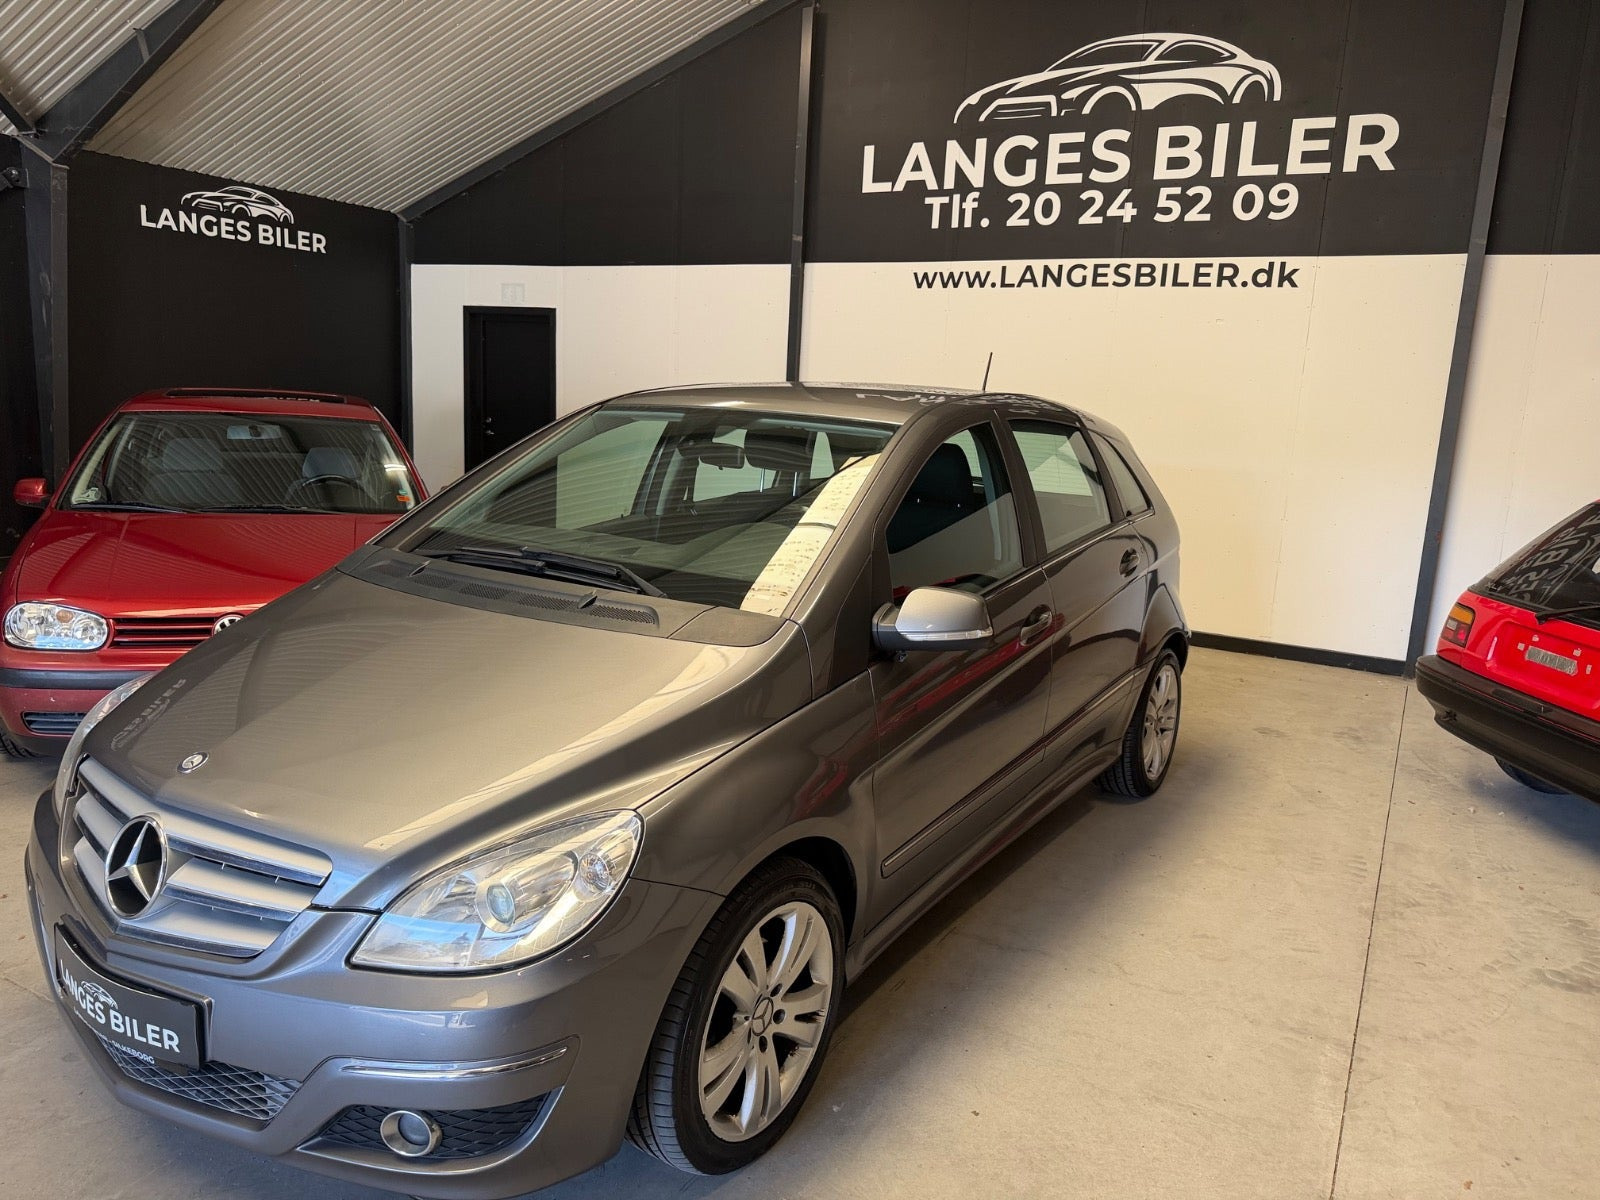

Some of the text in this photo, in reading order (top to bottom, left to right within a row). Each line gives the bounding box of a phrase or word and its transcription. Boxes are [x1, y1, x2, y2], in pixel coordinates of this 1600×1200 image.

[861, 113, 1400, 194] LANGES BILER
[140, 204, 327, 254] LANGES BILER
[924, 182, 1299, 230] Tlf. 20 24 52 09
[913, 261, 1300, 290] www.LANGESBILER.dk
[60, 958, 106, 1025] LANGES
[109, 1009, 181, 1053] BILER
